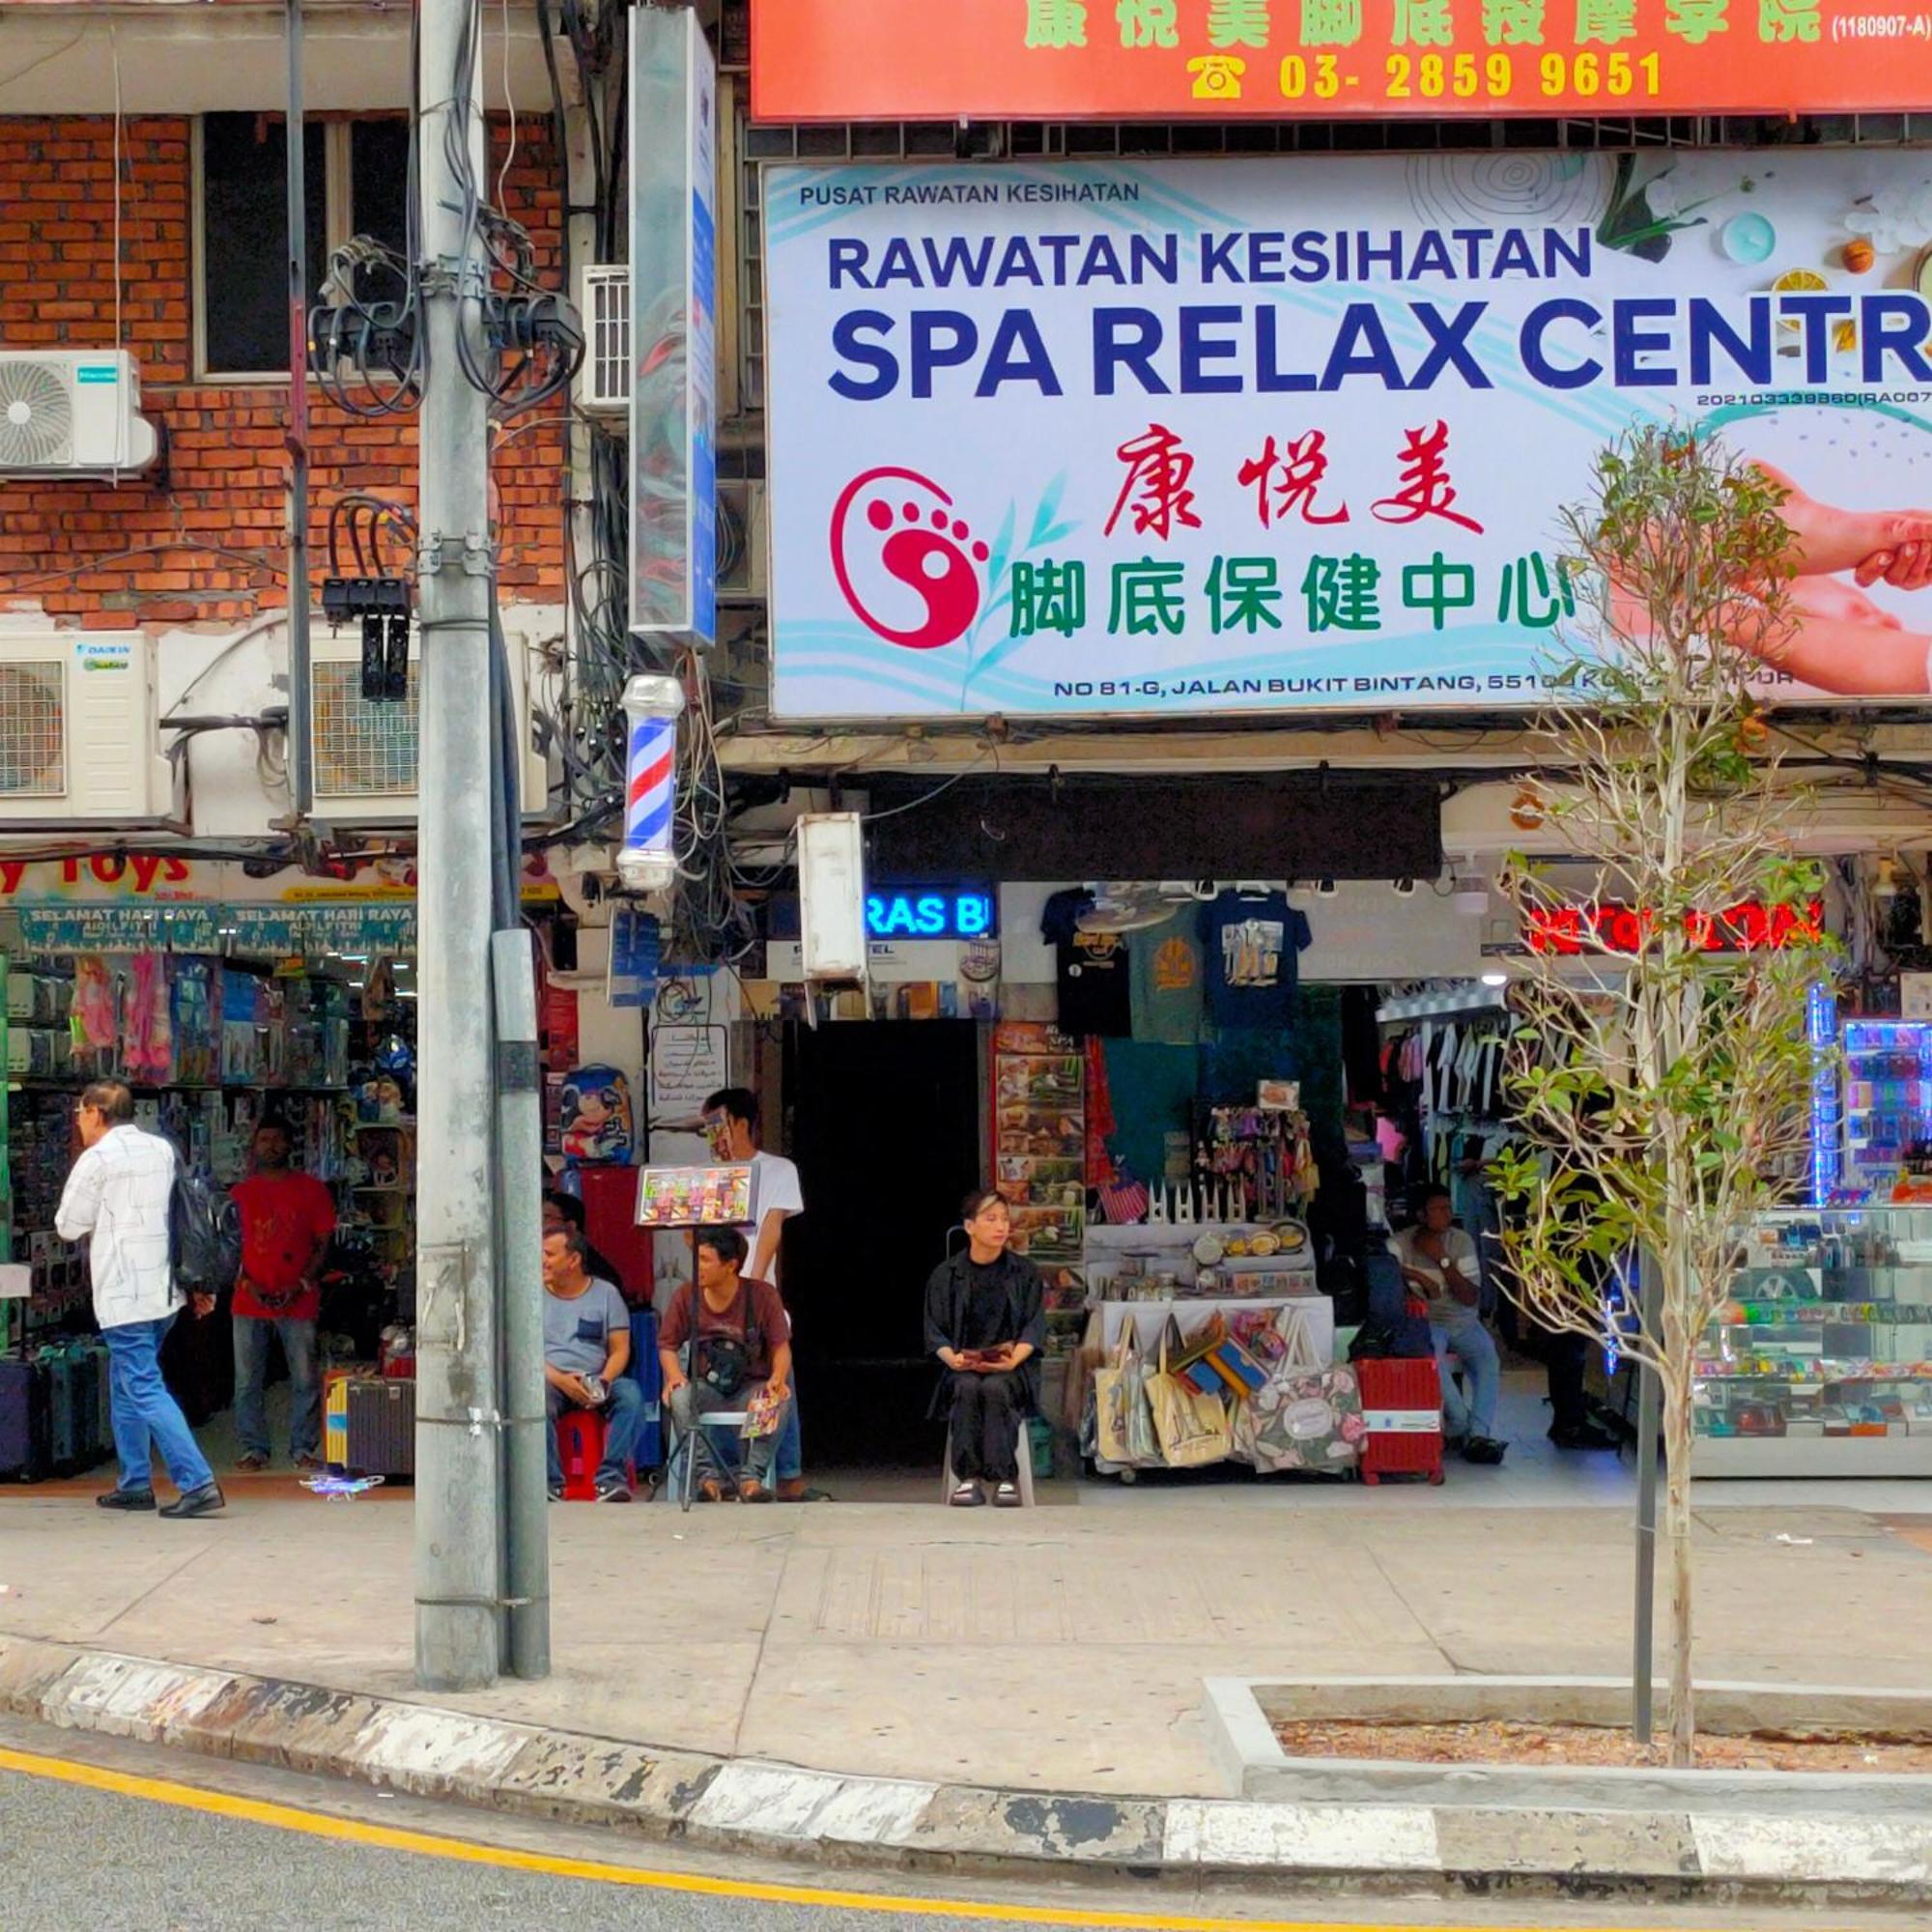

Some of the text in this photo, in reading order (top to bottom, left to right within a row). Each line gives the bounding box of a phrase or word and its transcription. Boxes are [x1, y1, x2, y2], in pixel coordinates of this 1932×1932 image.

[1832, 14, 1932, 43] (1180907-A)
[1280, 52, 1660, 99] 03- 2859 9651
[800, 183, 1140, 206] PUSAT RAWATAN KESIHATAN
[829, 228, 1591, 289] RAWATAN KESIHATAN
[828, 308, 1064, 401] SPA
[1093, 301, 1493, 395] RELAX
[1009, 551, 1576, 639] 脚底保健中心
[1054, 682, 1094, 696] NO
[1099, 681, 1166, 697] 81-G,
[1172, 679, 1262, 695] JALAN
[1267, 677, 1348, 693] BUKIT
[1354, 674, 1481, 693] BINTANG,
[29, 908, 115, 922] SELAMAT
[236, 908, 413, 923] SELAMAT HARI RAYA
